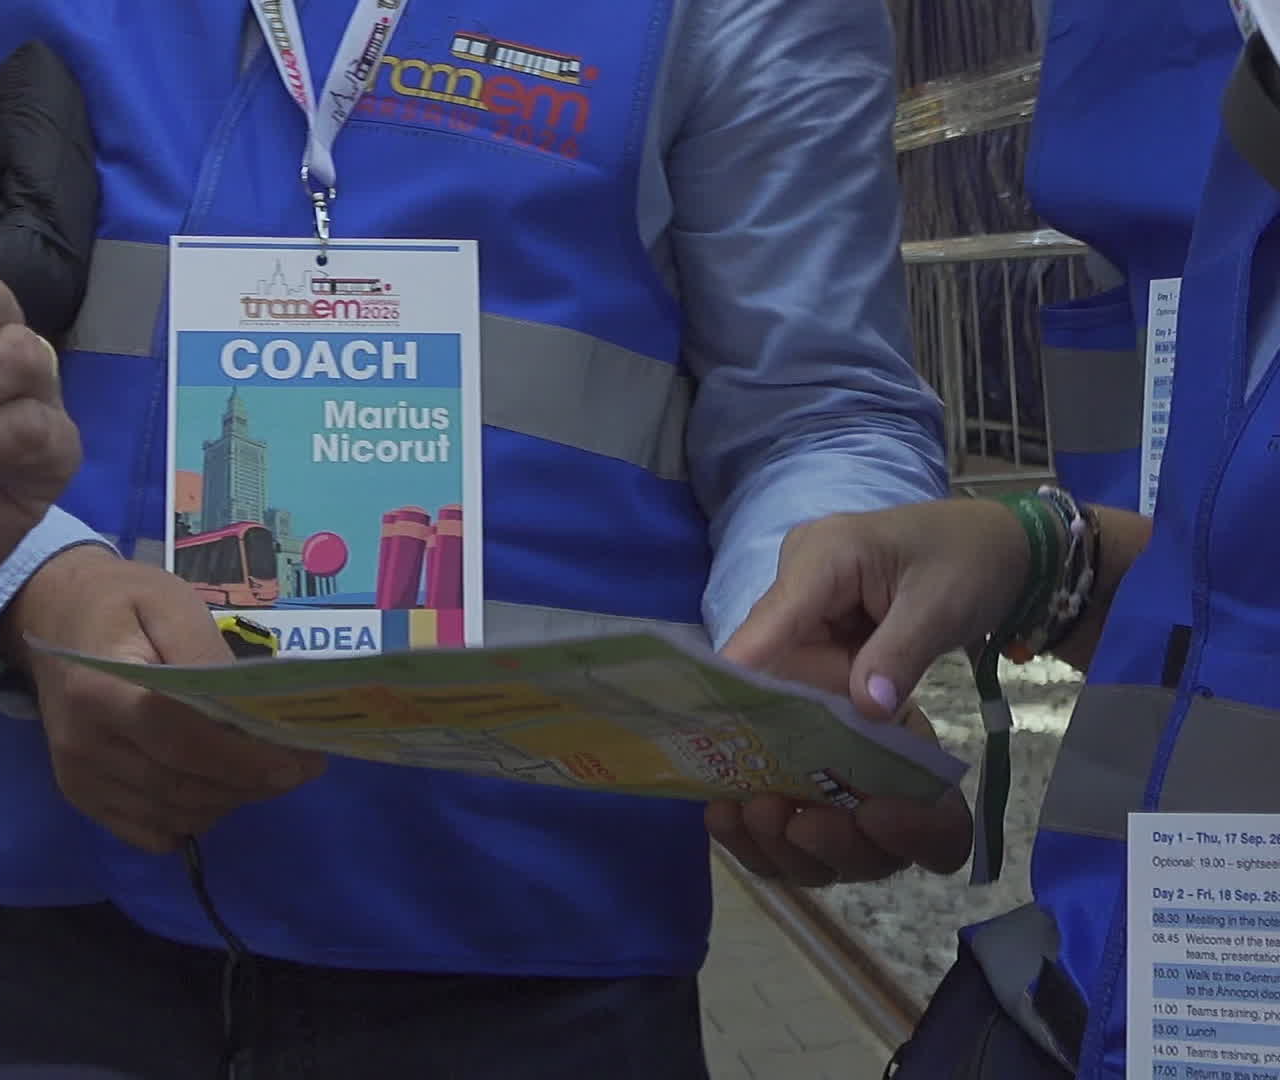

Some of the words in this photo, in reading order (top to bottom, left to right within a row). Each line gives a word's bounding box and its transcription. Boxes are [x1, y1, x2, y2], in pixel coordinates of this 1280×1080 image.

[362, 306, 401, 320] 2026
[221, 338, 417, 380] COACH
[324, 400, 450, 430] Marius
[1152, 832, 1174, 845] Day
[1196, 832, 1221, 845] Thu,
[1225, 833, 1236, 844] 17
[1240, 834, 1266, 847] Sep.
[1152, 856, 1197, 869] Optional:
[1199, 858, 1226, 868] 19.00
[1152, 887, 1174, 901] Day
[1177, 889, 1184, 899] 2
[1196, 889, 1216, 901] Fri,
[1220, 890, 1232, 900] 18
[1235, 890, 1260, 904] Sep.
[1186, 914, 1226, 928] Meeting
[1228, 915, 1238, 926] in
[1239, 916, 1256, 926] the
[1152, 933, 1180, 944] 08.45
[1186, 934, 1231, 946] Welcome
[1234, 934, 1246, 946] of
[1247, 935, 1263, 946] the
[1186, 950, 1218, 961] teams,
[1153, 968, 1180, 979] 10.00
[1185, 969, 1210, 981] Walk
[1224, 971, 1241, 982] the
[1186, 986, 1196, 997] to
[1197, 986, 1214, 997] the
[1216, 987, 1259, 1000] Annopol
[1153, 1004, 1178, 1014] 11.00
[1186, 1004, 1219, 1017] Teams
[1221, 1006, 1261, 1021] training,
[1153, 1024, 1179, 1035] 13.00
[1186, 1026, 1217, 1038] Lunch
[1153, 1045, 1179, 1056] 14.00
[1186, 1046, 1219, 1059] Teams
[1221, 1049, 1260, 1063] training,
[1153, 1066, 1177, 1077] 17.00
